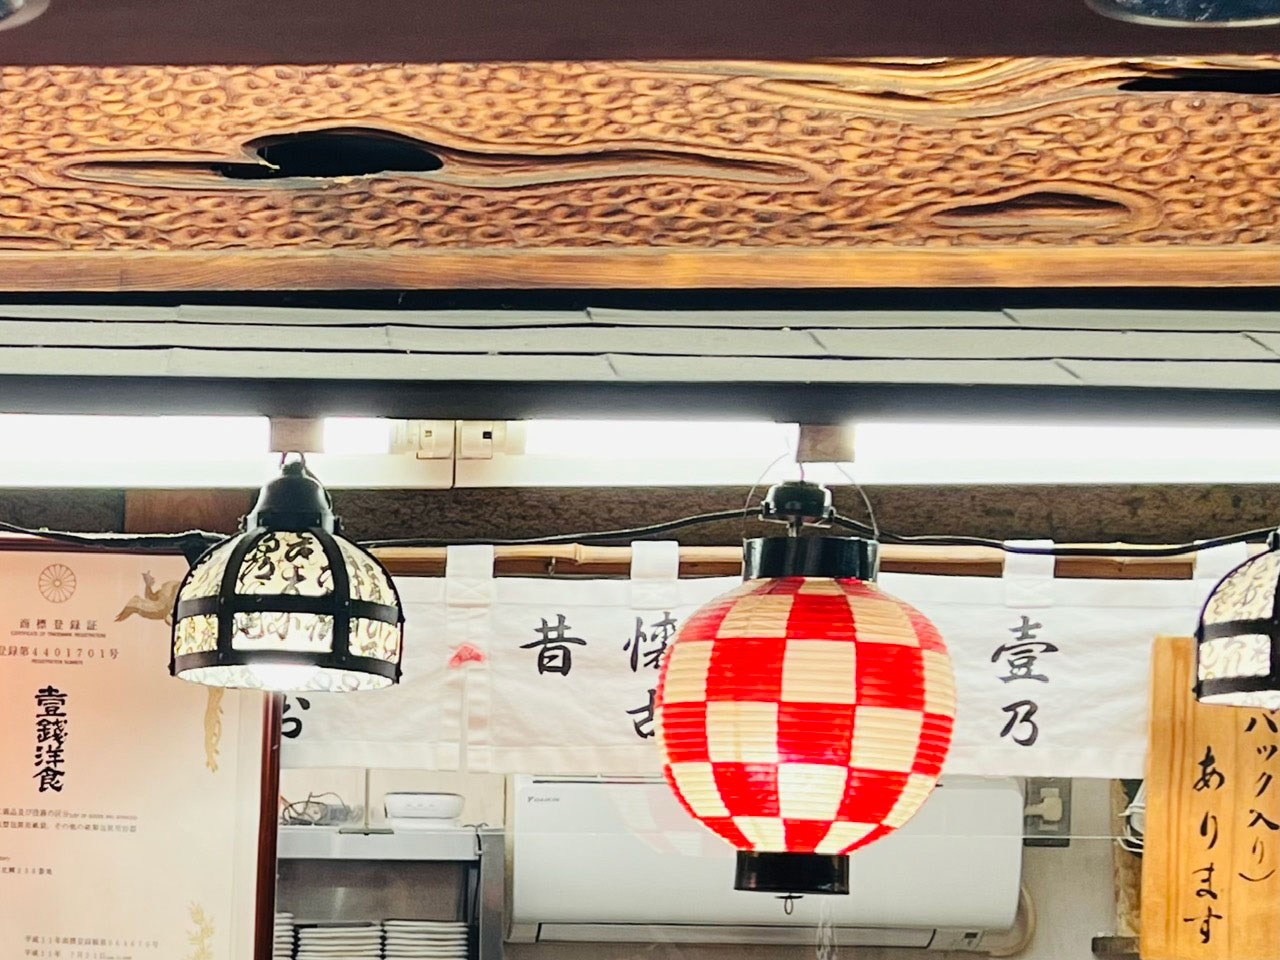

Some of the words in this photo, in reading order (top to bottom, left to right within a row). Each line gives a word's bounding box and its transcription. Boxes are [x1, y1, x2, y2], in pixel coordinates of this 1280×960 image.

[520, 614, 587, 677] 昔
[1184, 746, 1226, 945] あります
